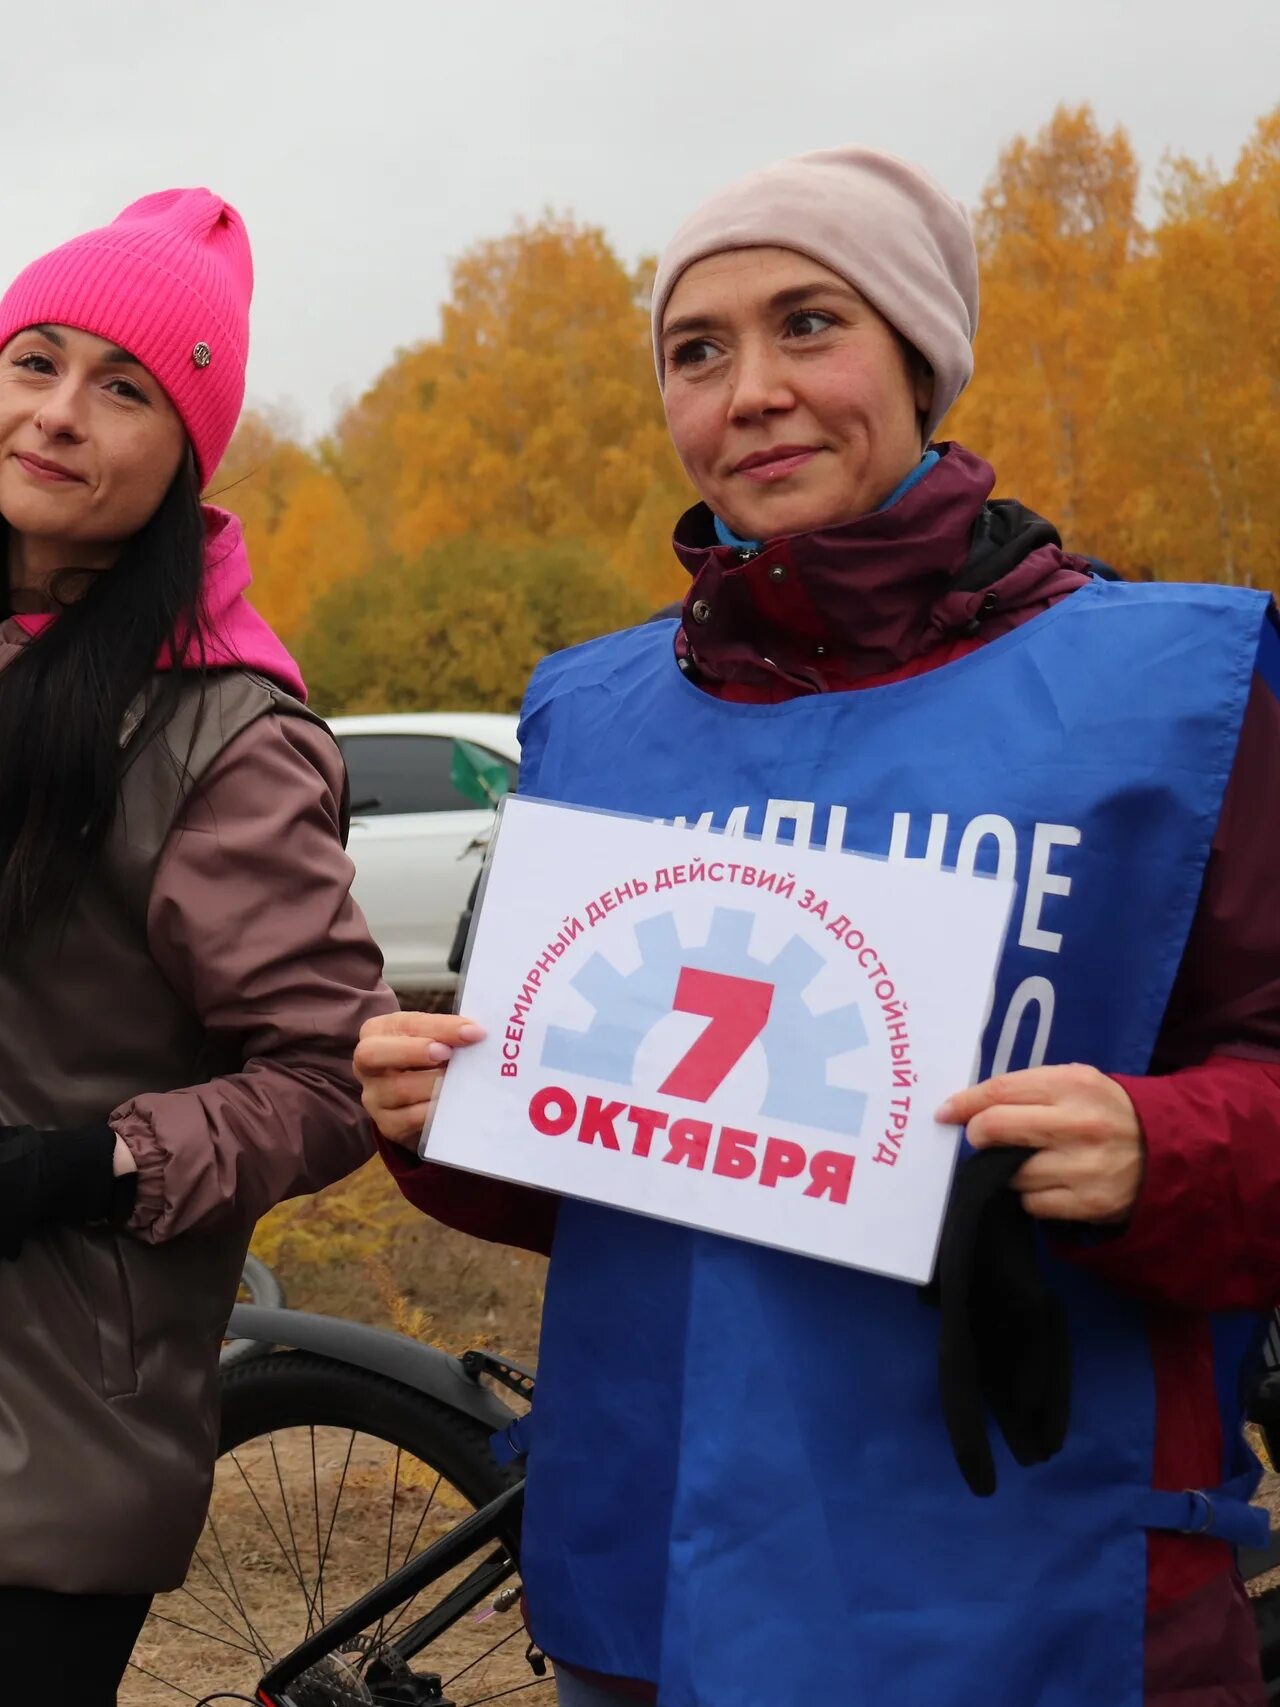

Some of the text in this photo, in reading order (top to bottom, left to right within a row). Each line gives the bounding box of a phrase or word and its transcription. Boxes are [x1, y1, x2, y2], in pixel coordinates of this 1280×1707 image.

[501, 915, 585, 1077] ВСЕМИРНЫЙ
[585, 878, 650, 927] ДЕНЬ
[654, 856, 797, 899] ДЕЙСТВИЙ
[797, 888, 830, 921] ЗА
[825, 914, 919, 1088] ДОСТОЙНЫЙ
[872, 1096, 912, 1167] ТРУД
[656, 966, 776, 1104] 7
[528, 1085, 857, 1205] ОКТЯБРЯ
